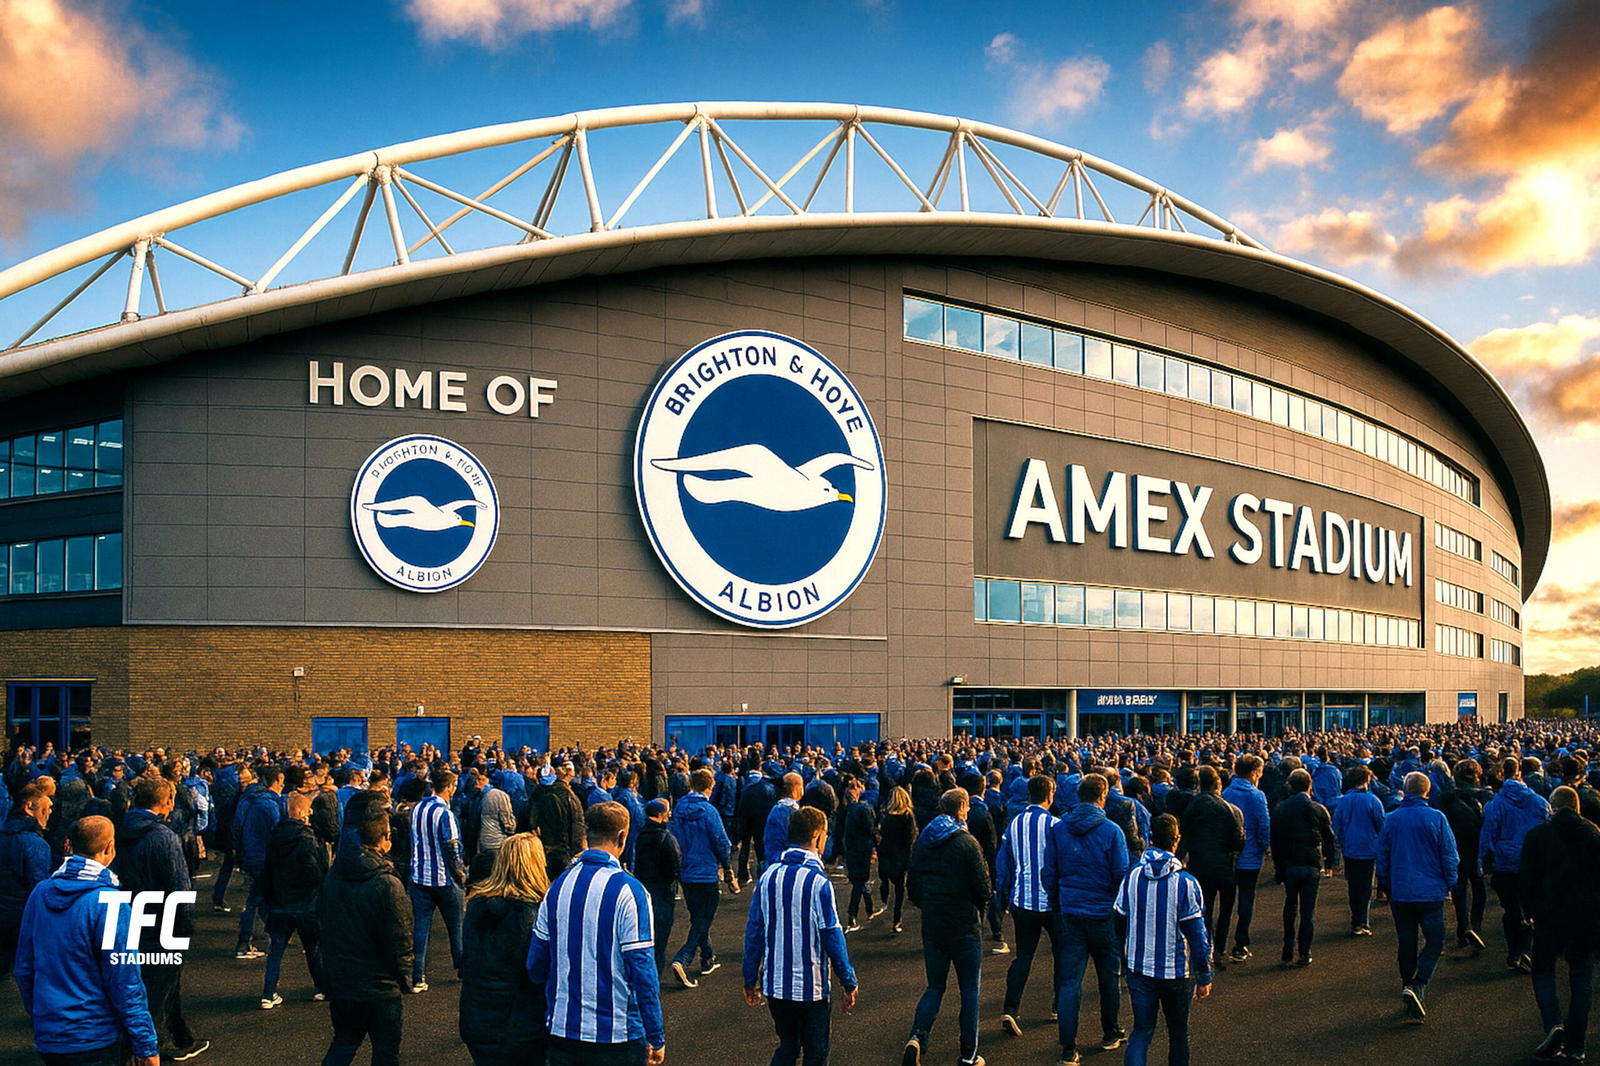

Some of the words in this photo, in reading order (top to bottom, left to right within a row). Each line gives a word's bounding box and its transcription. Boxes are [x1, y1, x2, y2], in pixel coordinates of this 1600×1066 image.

[308, 360, 468, 412] HOME
[486, 375, 558, 418] OF
[665, 346, 777, 416] BRIGHTON
[789, 355, 804, 374] &
[1004, 457, 1215, 558] AMEX
[1229, 492, 1413, 587] STADIUM
[396, 565, 453, 582] ALBION
[718, 581, 821, 612] ALBION
